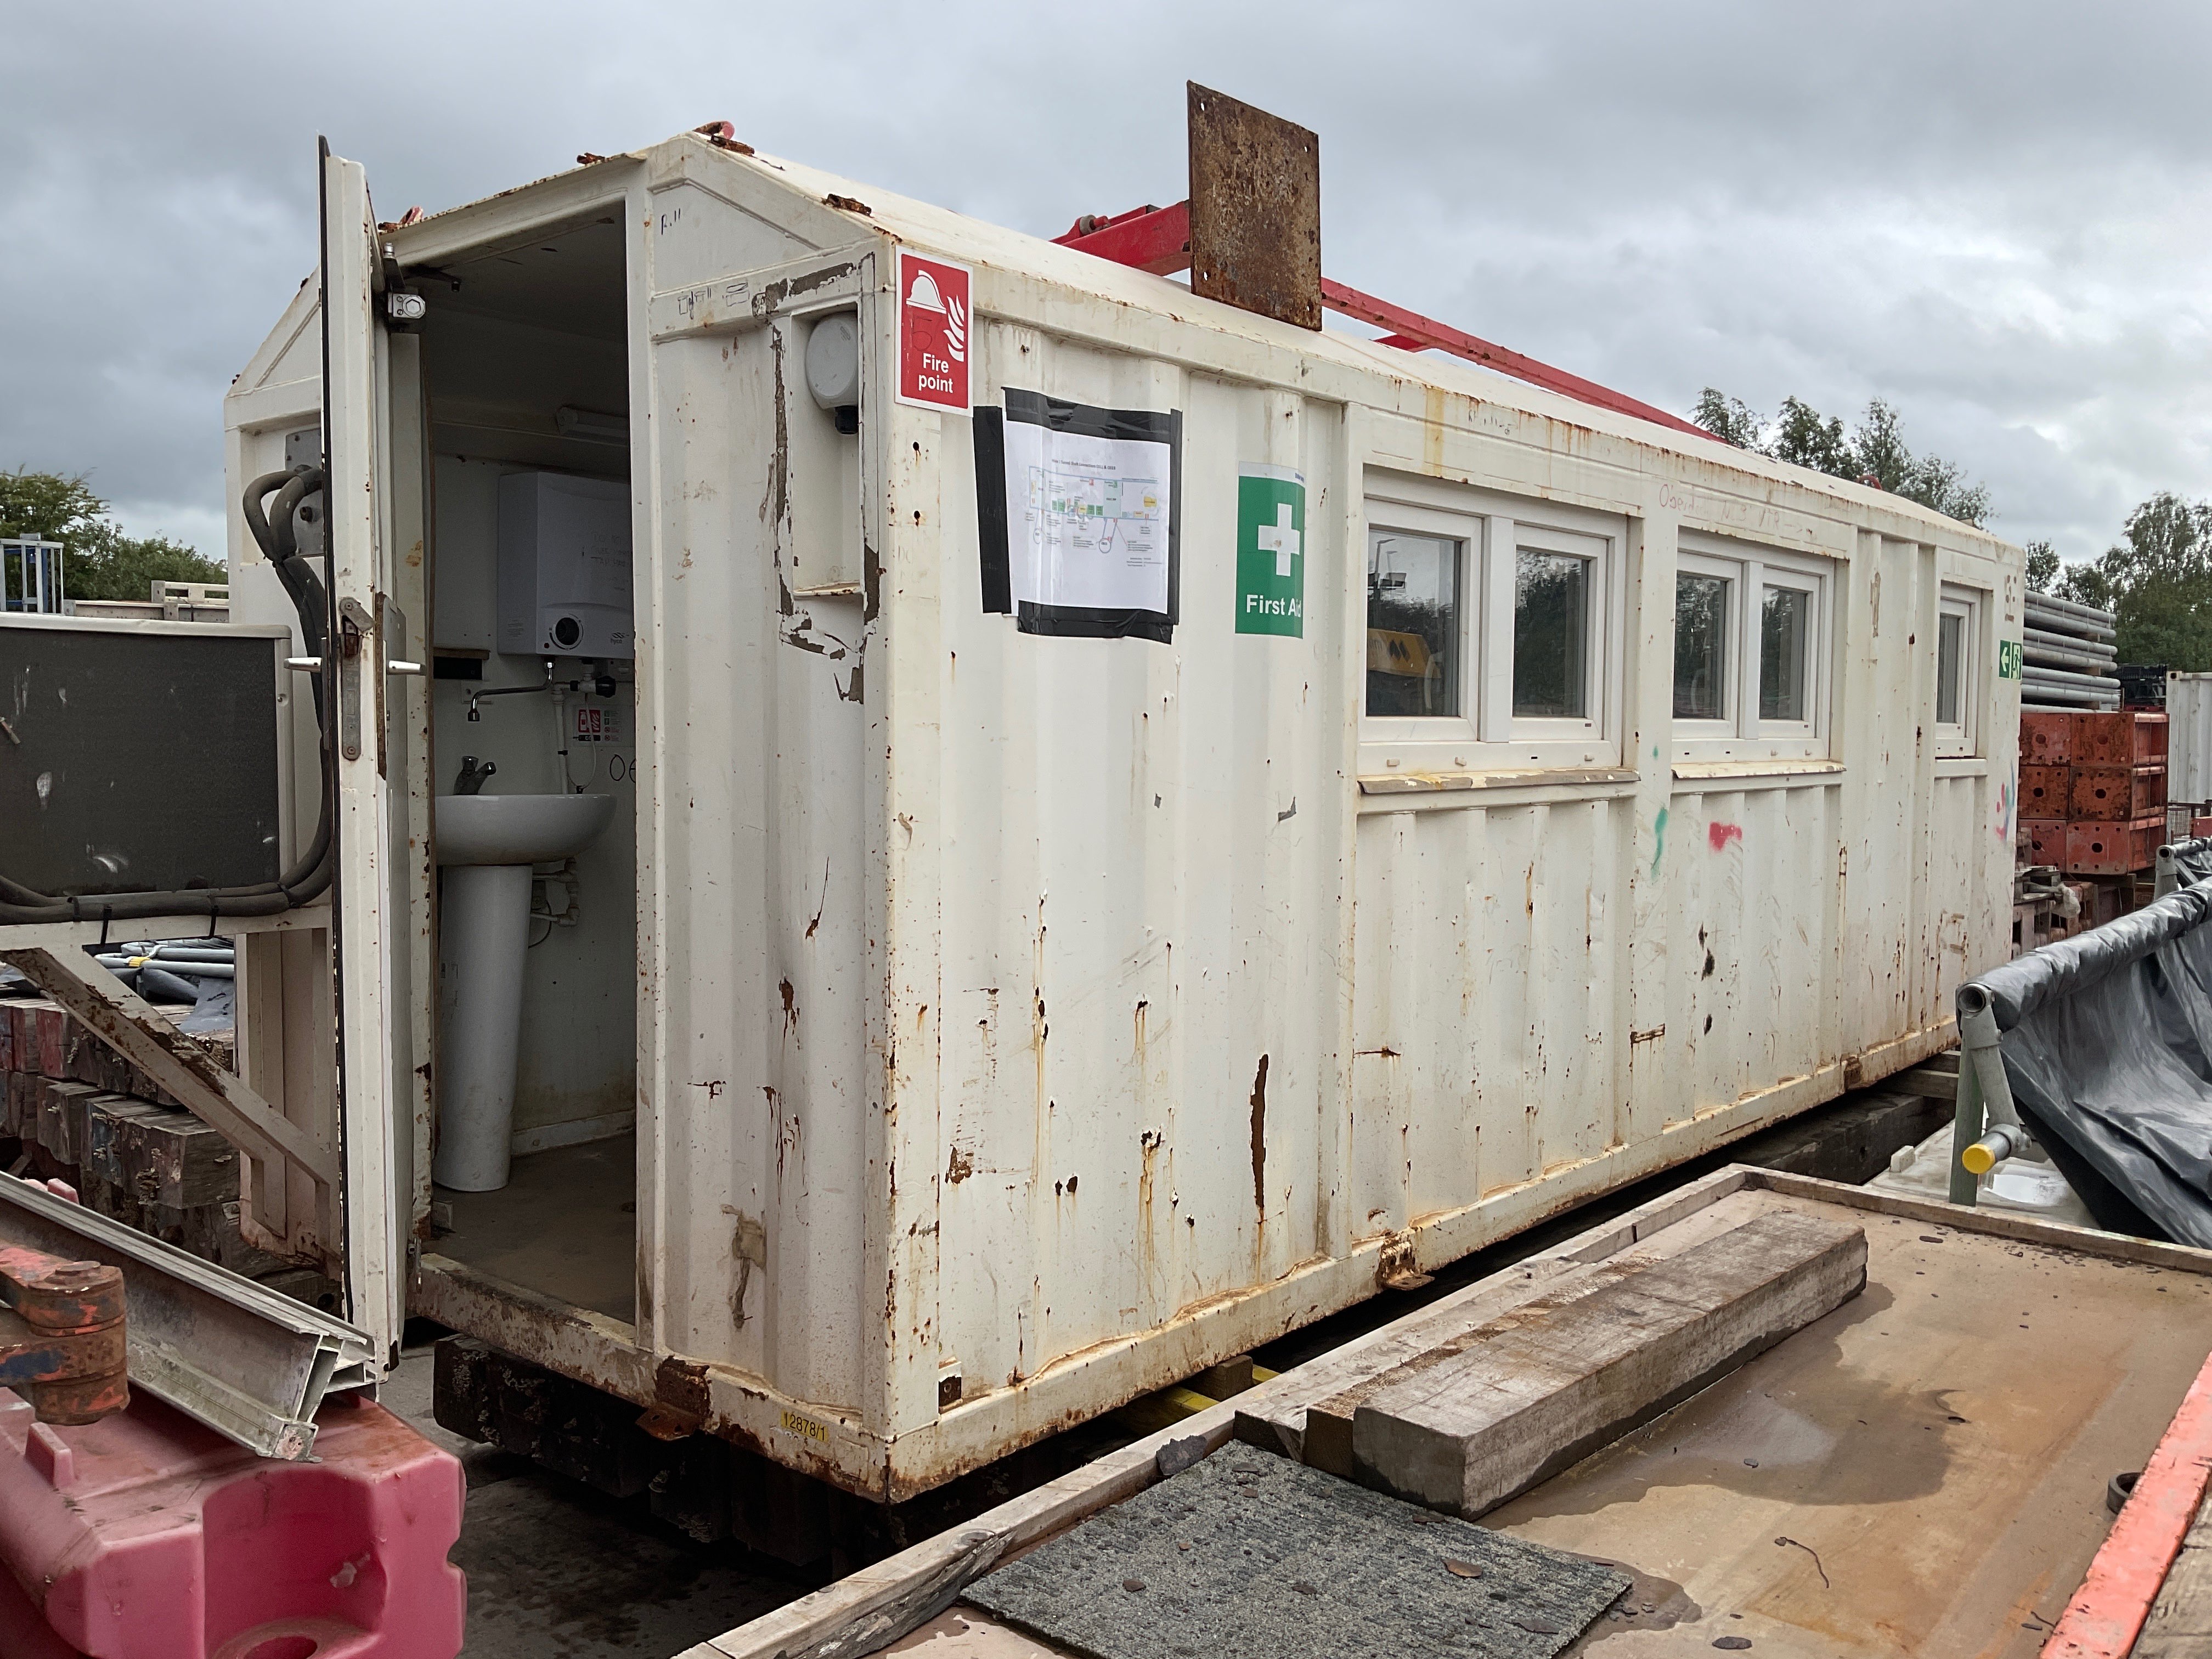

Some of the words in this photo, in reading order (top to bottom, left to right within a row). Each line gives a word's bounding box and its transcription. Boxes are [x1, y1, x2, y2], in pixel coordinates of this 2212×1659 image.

[923, 353, 949, 374] Fire
[918, 374, 953, 393] point
[1246, 594, 1285, 616] First
[1288, 597, 1301, 618] Aid
[784, 1412, 826, 1441] 12878/1
